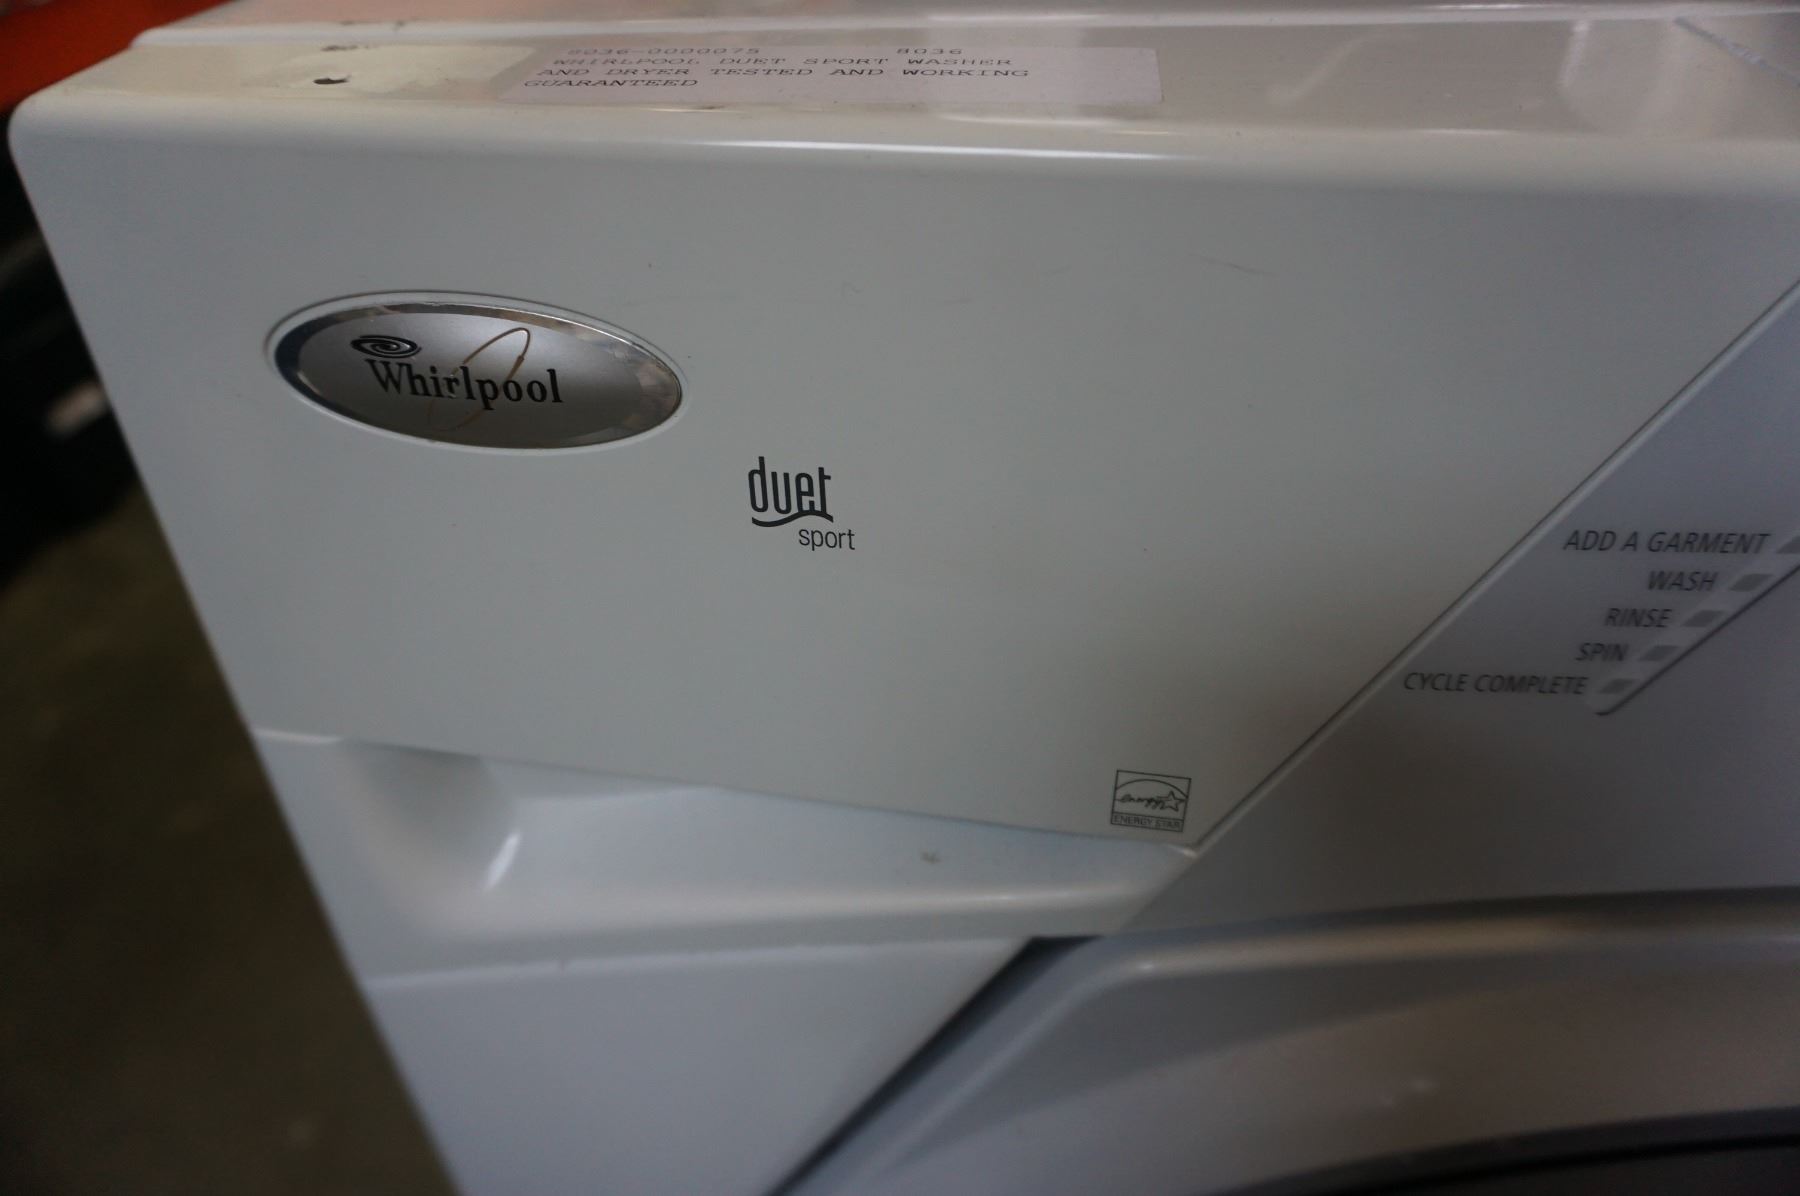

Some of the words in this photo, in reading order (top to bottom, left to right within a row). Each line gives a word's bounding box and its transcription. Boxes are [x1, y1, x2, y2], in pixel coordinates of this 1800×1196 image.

[523, 79, 699, 87] GUARANTEED
[902, 69, 1029, 77] WORKING
[364, 358, 564, 411] Whirlpool
[748, 456, 833, 523] duet
[798, 528, 856, 551] sport
[1563, 530, 1617, 551] ADD
[1622, 531, 1640, 551] A
[1647, 531, 1772, 553] GARMENT
[1647, 570, 1719, 592] WASH
[1603, 608, 1673, 628] RINSE
[1575, 642, 1630, 662] SPIN
[1403, 672, 1469, 692] CYCLE
[1473, 674, 1589, 695] COMPLETE
[1113, 815, 1153, 826] ENERGY
